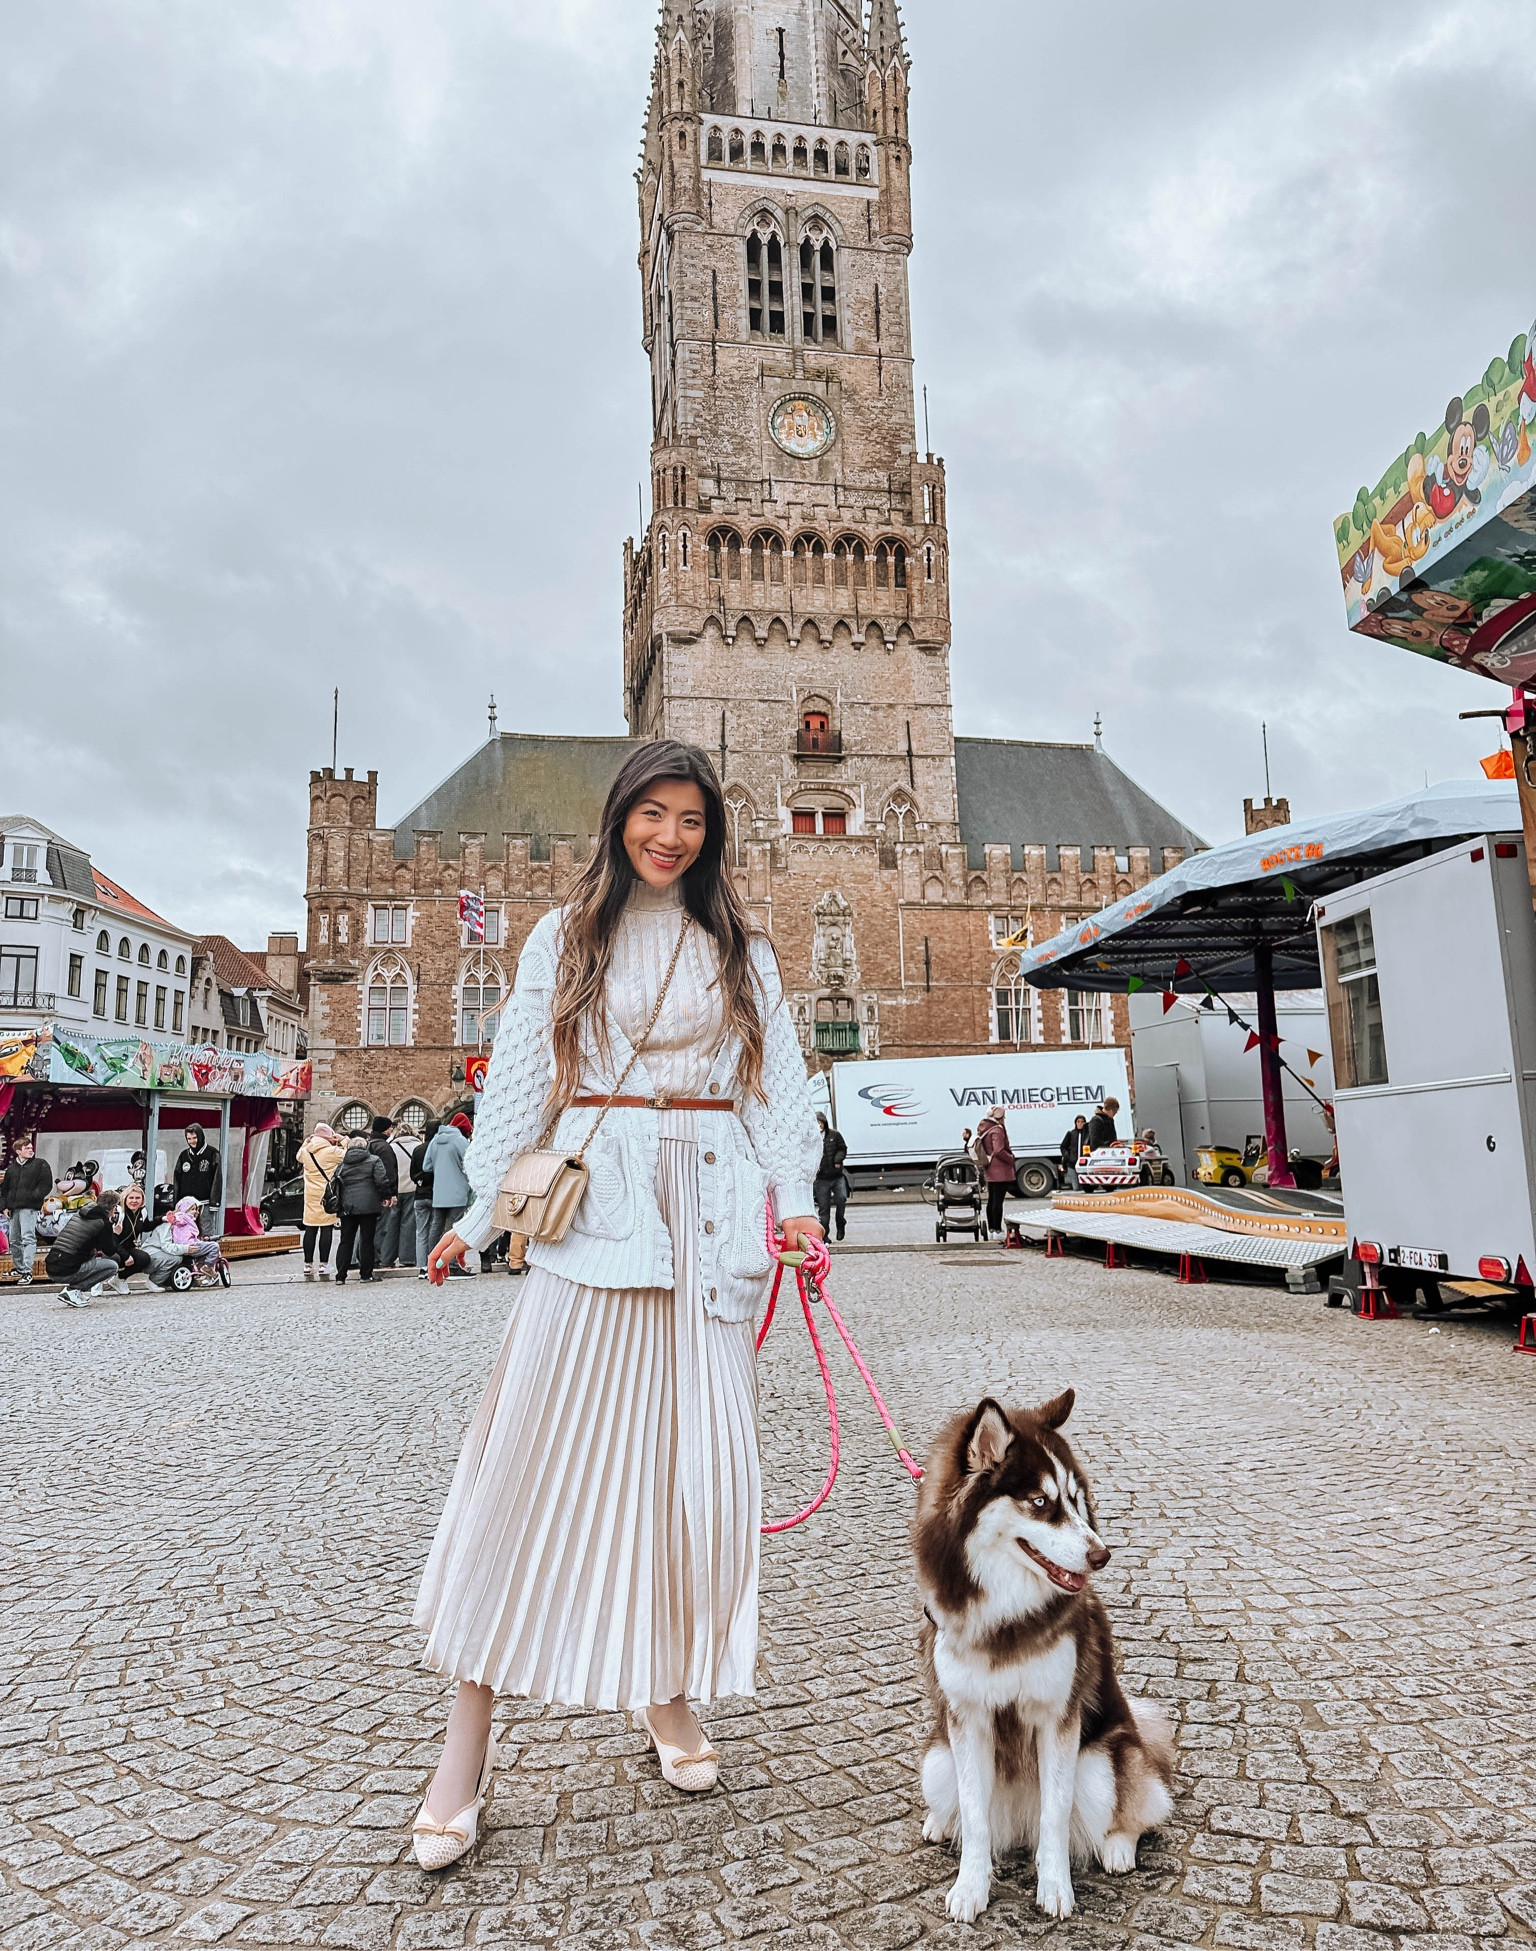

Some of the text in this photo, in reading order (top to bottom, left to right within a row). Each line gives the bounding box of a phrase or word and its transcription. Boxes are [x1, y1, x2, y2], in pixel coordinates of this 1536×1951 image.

[1260, 843, 1324, 872] ROUTE 66
[949, 1085, 1105, 1107] VAN MIEGHEM
[1001, 1102, 1056, 1111] LOGISTICS
